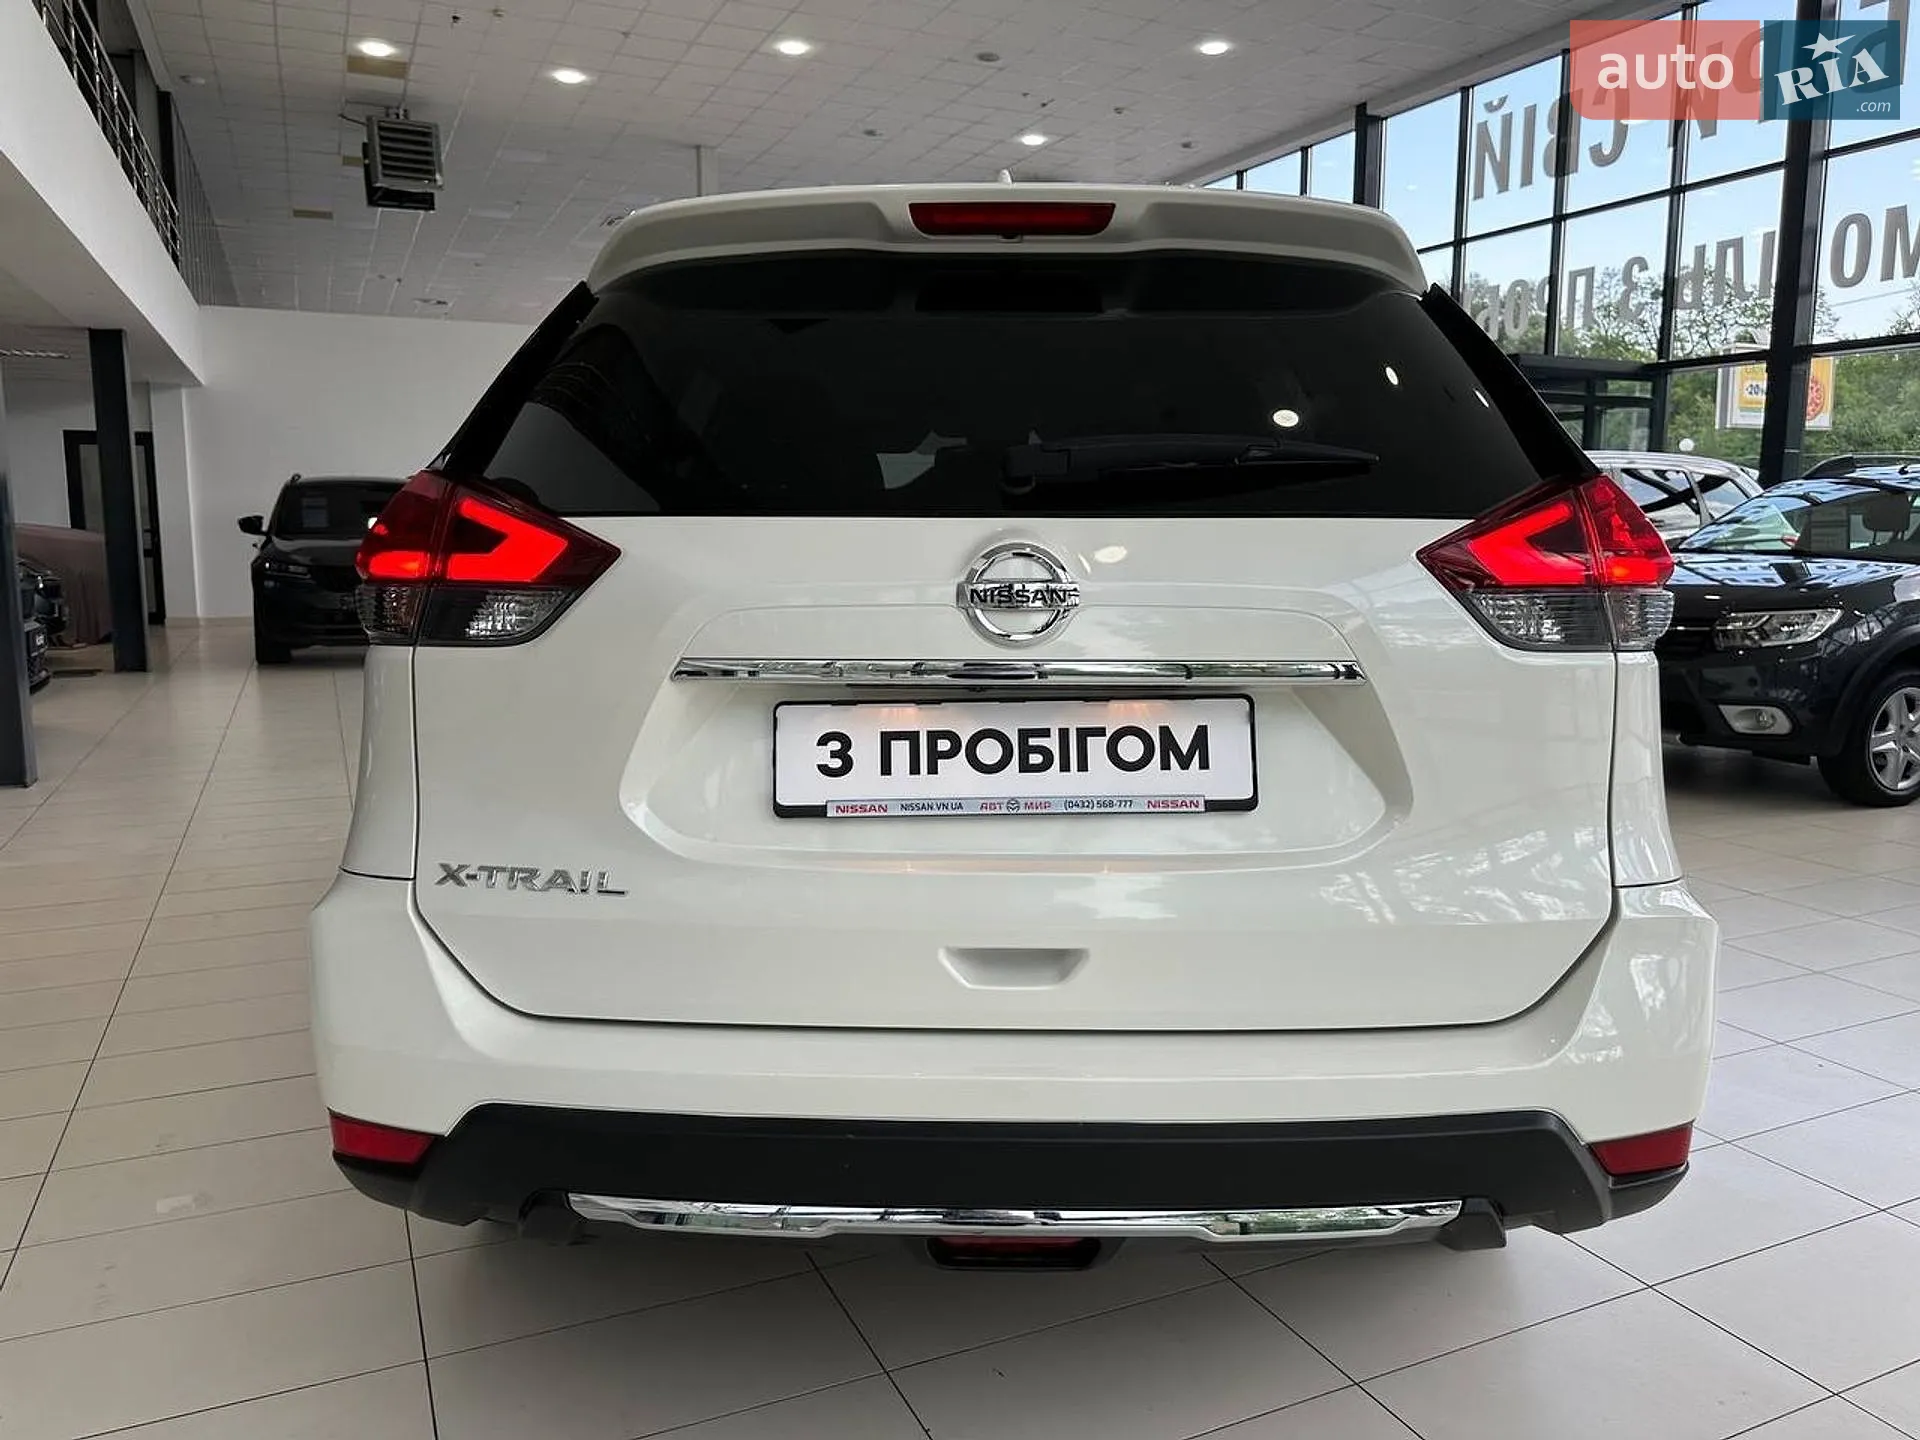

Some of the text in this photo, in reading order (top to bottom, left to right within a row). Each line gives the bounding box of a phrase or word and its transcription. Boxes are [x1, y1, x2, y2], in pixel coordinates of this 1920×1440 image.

[969, 587, 1067, 604] NISSAN
[816, 724, 1210, 777] З ПРОБІГОМ
[835, 803, 888, 814] NISSAN
[1063, 799, 1095, 811] (0432)
[1146, 799, 1200, 810] NISSAN
[434, 862, 627, 895] X-TRAIL
